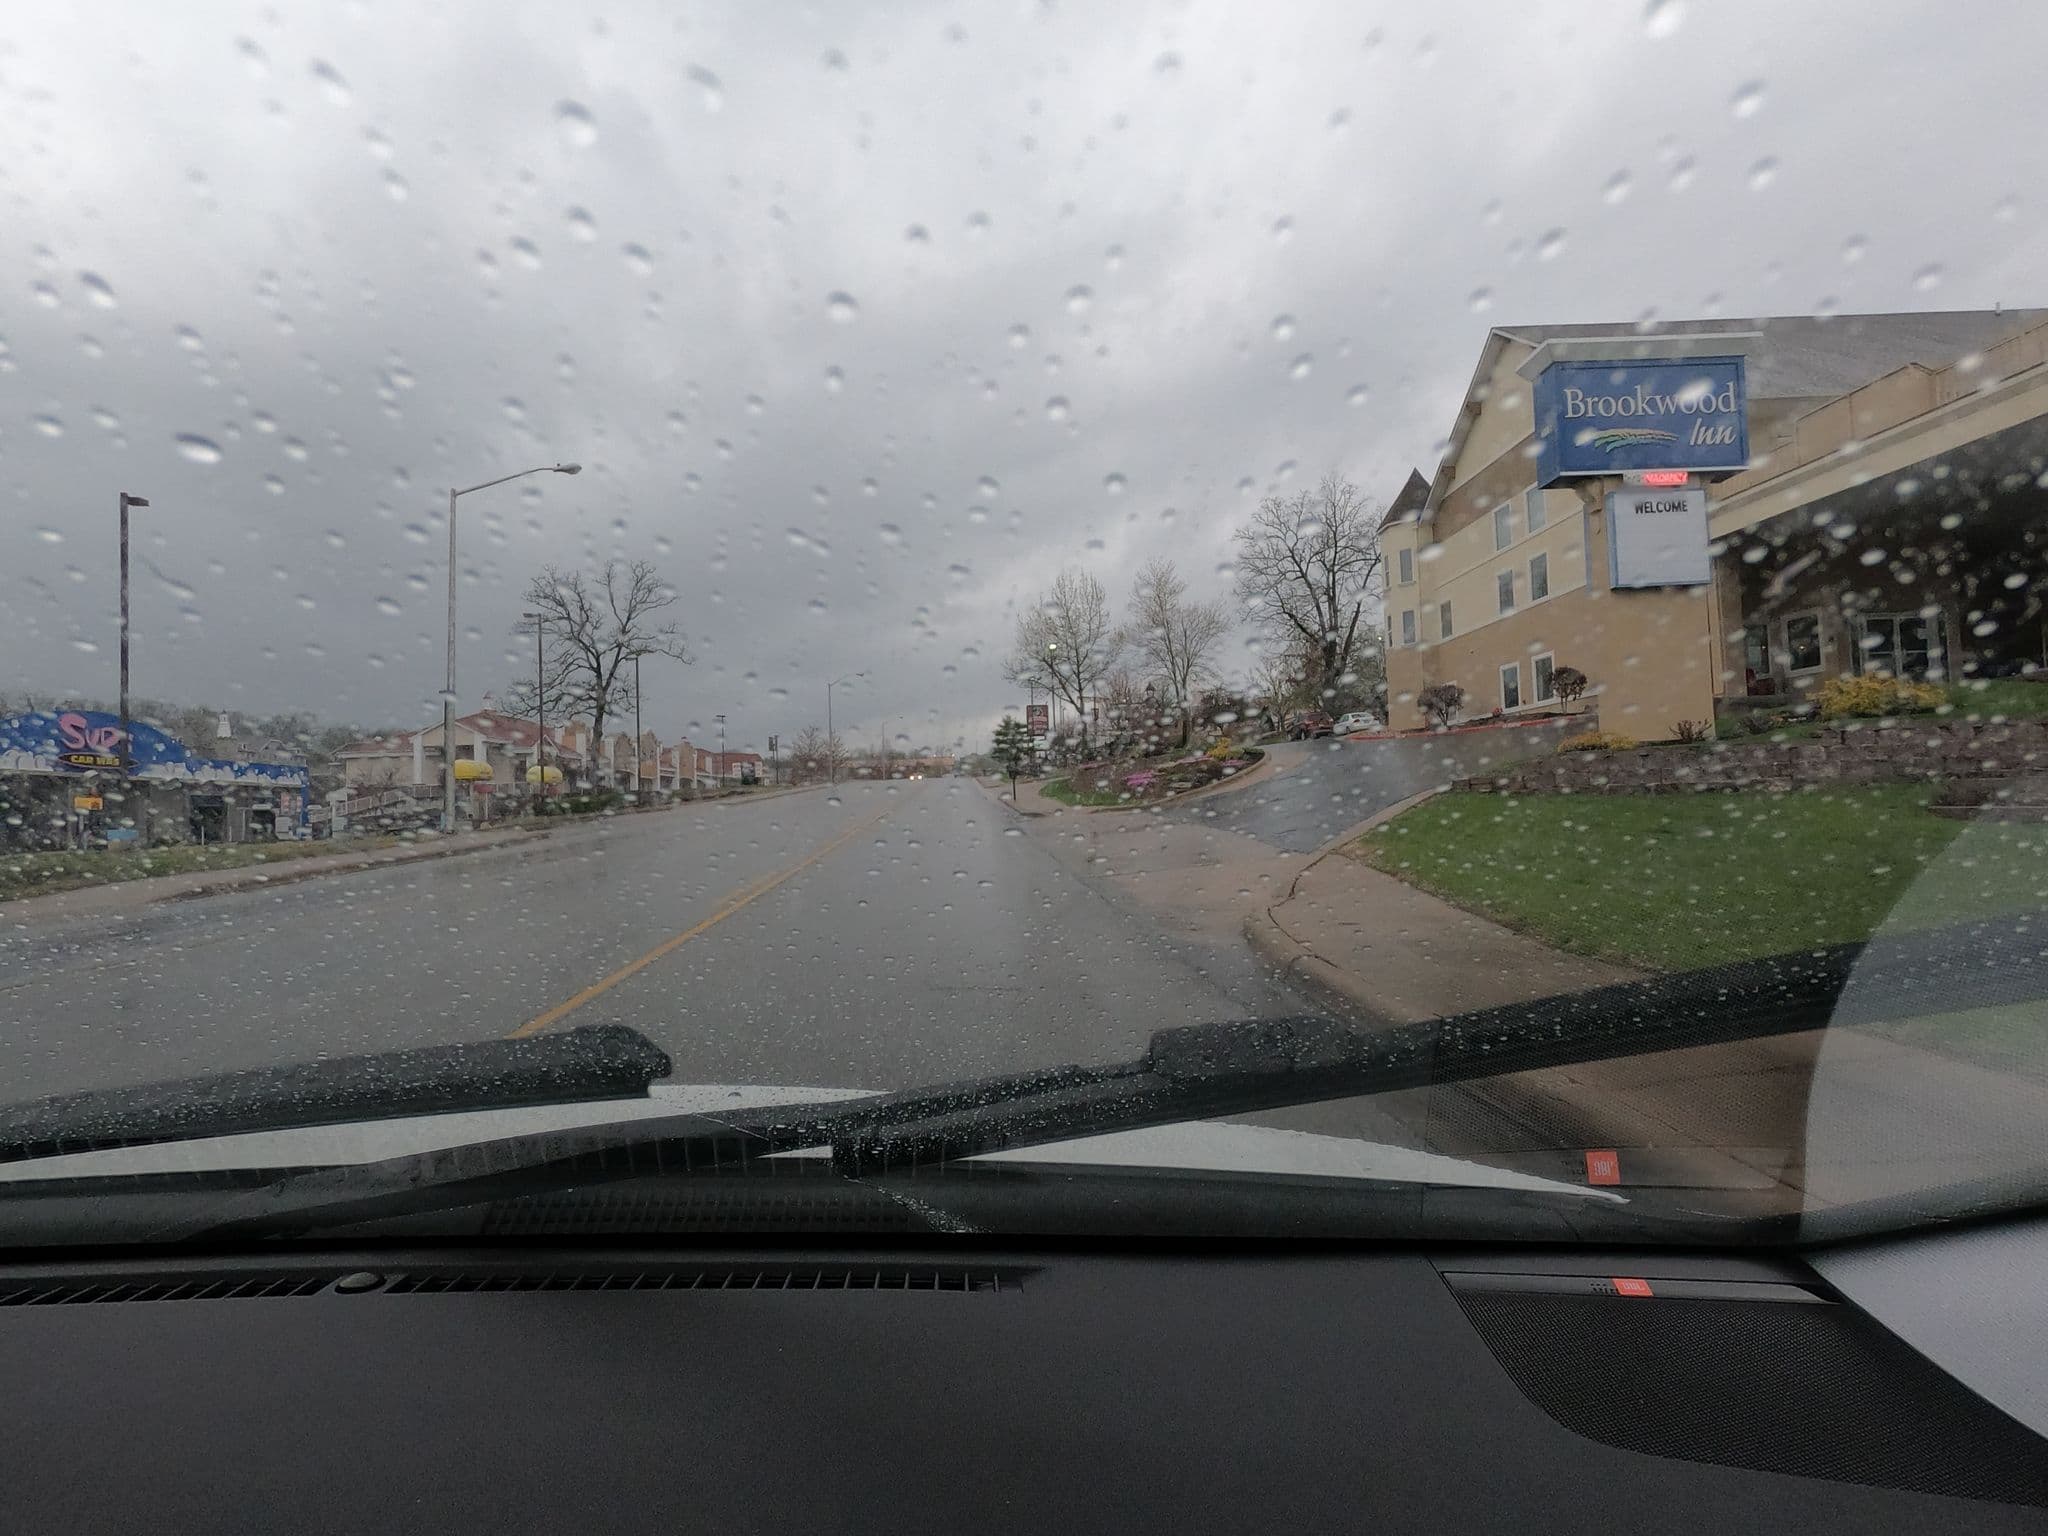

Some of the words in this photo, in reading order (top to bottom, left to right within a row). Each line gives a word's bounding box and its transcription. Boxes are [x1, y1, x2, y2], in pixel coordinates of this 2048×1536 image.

[1563, 381, 1738, 419] Brookwood
[1689, 417, 1737, 446] Inn
[1634, 500, 1688, 514] WELCOME
[96, 757, 121, 767] WAS
